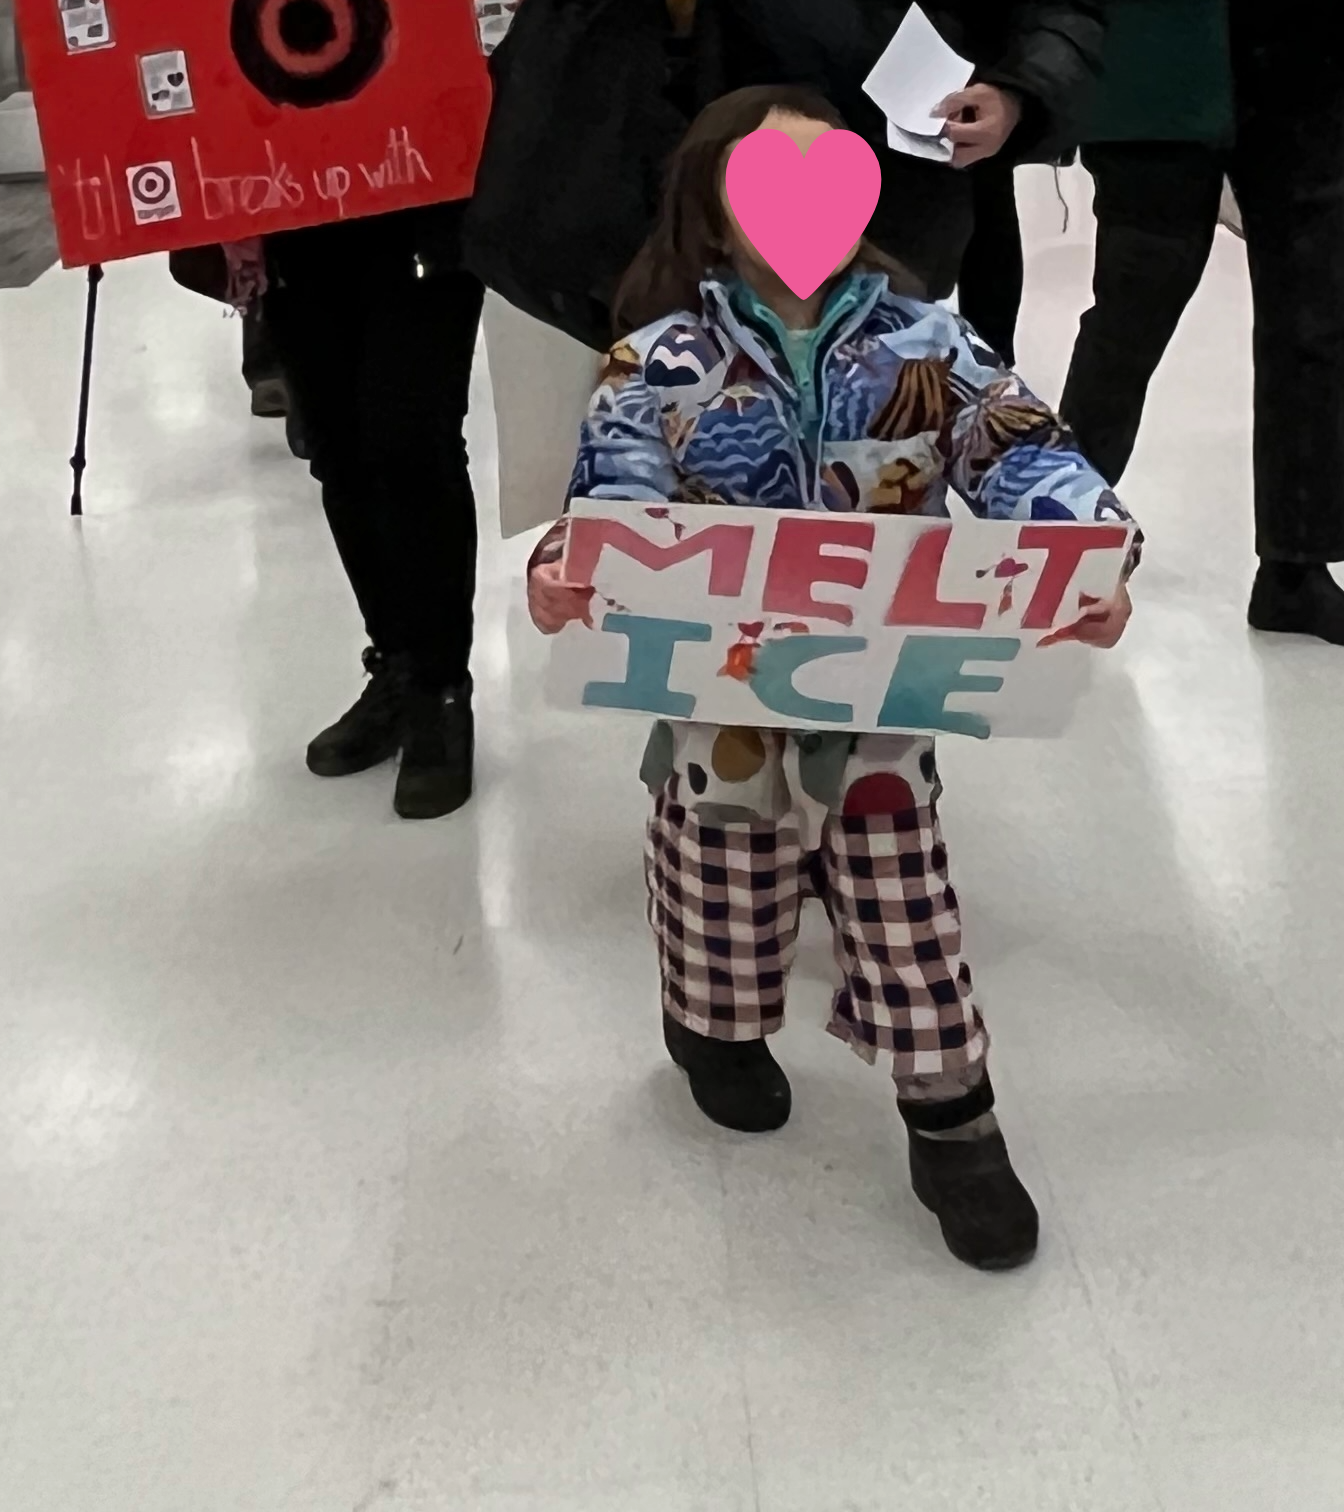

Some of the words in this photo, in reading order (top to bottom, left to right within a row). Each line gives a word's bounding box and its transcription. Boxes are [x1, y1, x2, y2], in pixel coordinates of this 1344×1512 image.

[312, 164, 353, 220] up
[358, 124, 435, 190] with
[559, 516, 1129, 630] MELT
[581, 612, 1022, 740] ICE
